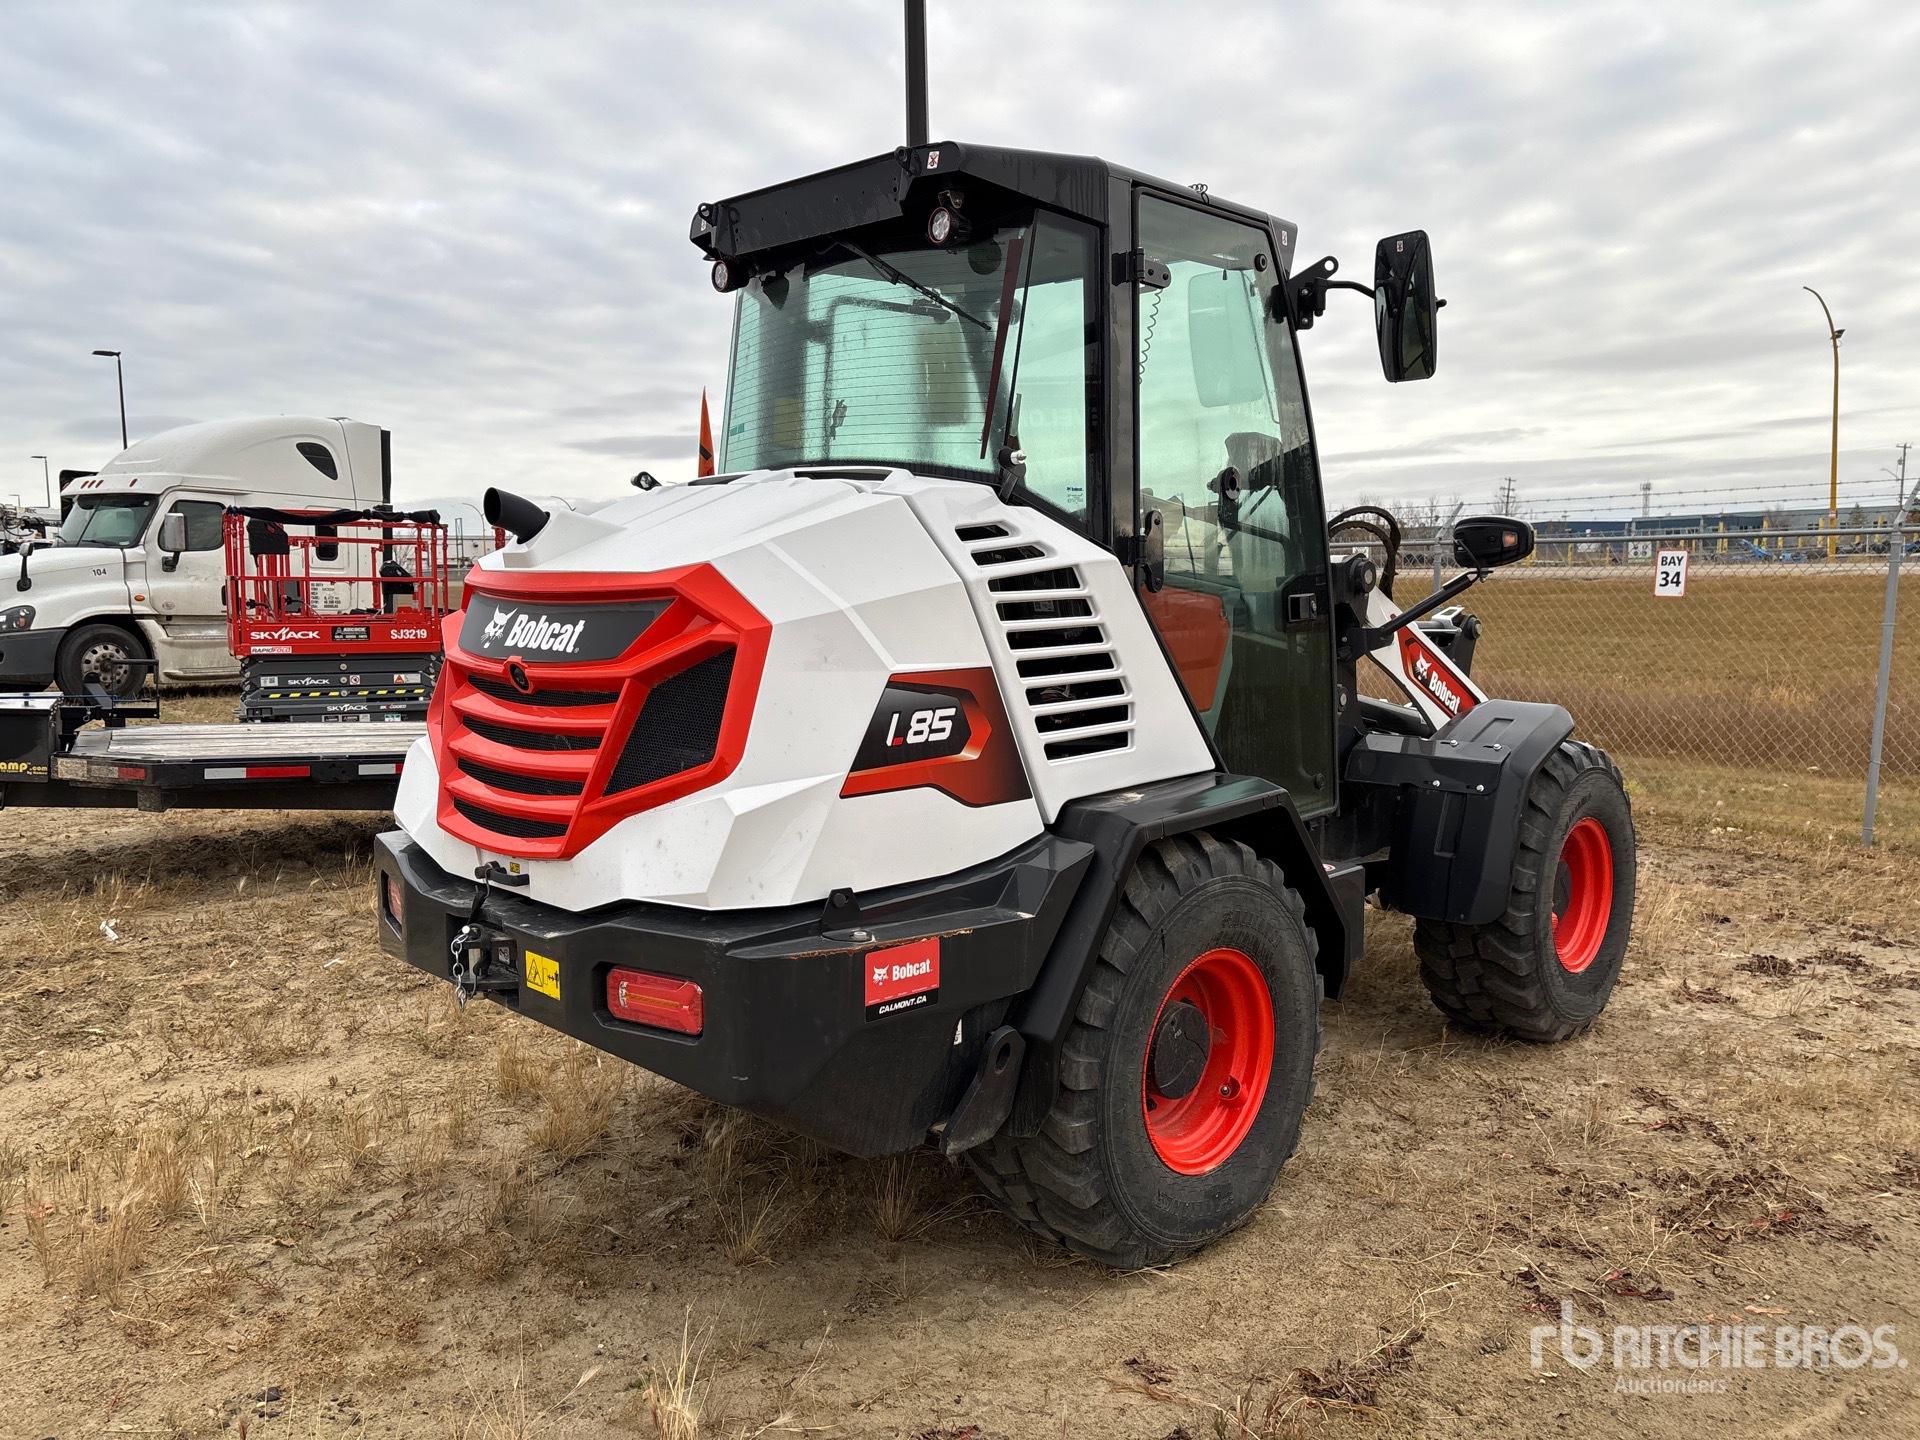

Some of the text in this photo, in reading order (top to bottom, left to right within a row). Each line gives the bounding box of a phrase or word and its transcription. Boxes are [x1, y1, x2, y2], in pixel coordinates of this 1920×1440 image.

[1660, 555, 1684, 567] BAY
[92, 568, 107, 576] 104
[1658, 570, 1682, 587] 34
[250, 626, 320, 641] SKYJACK
[390, 628, 428, 640] SJ3219
[504, 613, 585, 653] Bobcat
[287, 676, 330, 686] SKYJACK
[1428, 670, 1461, 715] Bobcat
[326, 703, 368, 712] SKYJACK
[892, 958, 931, 982] Bobcat
[878, 995, 927, 1015] CALMONT.CA
